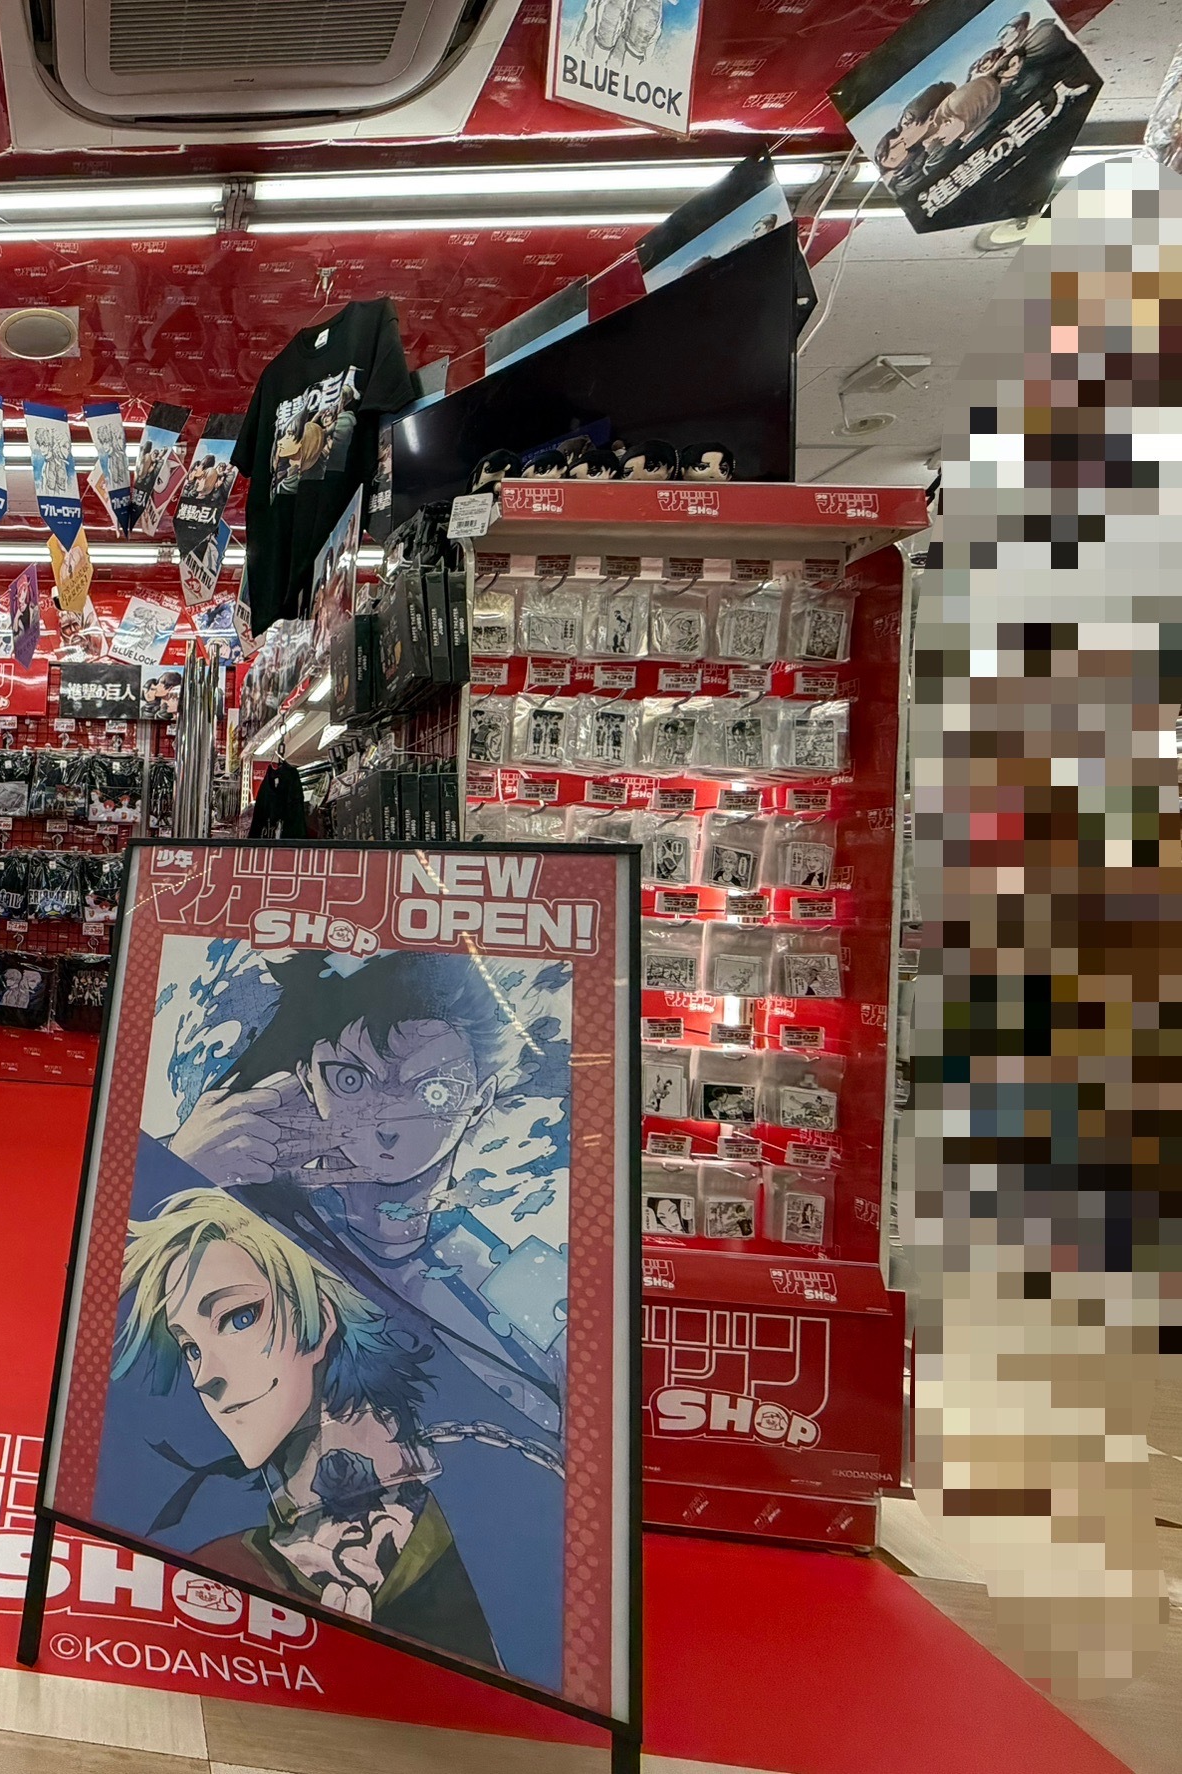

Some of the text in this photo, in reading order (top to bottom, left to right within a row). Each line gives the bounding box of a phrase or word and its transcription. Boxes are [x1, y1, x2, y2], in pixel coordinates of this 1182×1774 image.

[563, 54, 683, 117] BLUE LOCK
[918, 79, 1091, 219] 進撃の巨人
[40, 503, 82, 519] ブルーロック
[67, 682, 136, 702] 進撃の巨人
[156, 848, 194, 868] 少年
[399, 853, 536, 899] NEW
[150, 846, 390, 931] マガジン
[253, 909, 379, 956] SHOP
[398, 900, 596, 951] OPEN!
[656, 1389, 819, 1448] SHOP
[49, 1631, 325, 1694] ©KODANSHA
